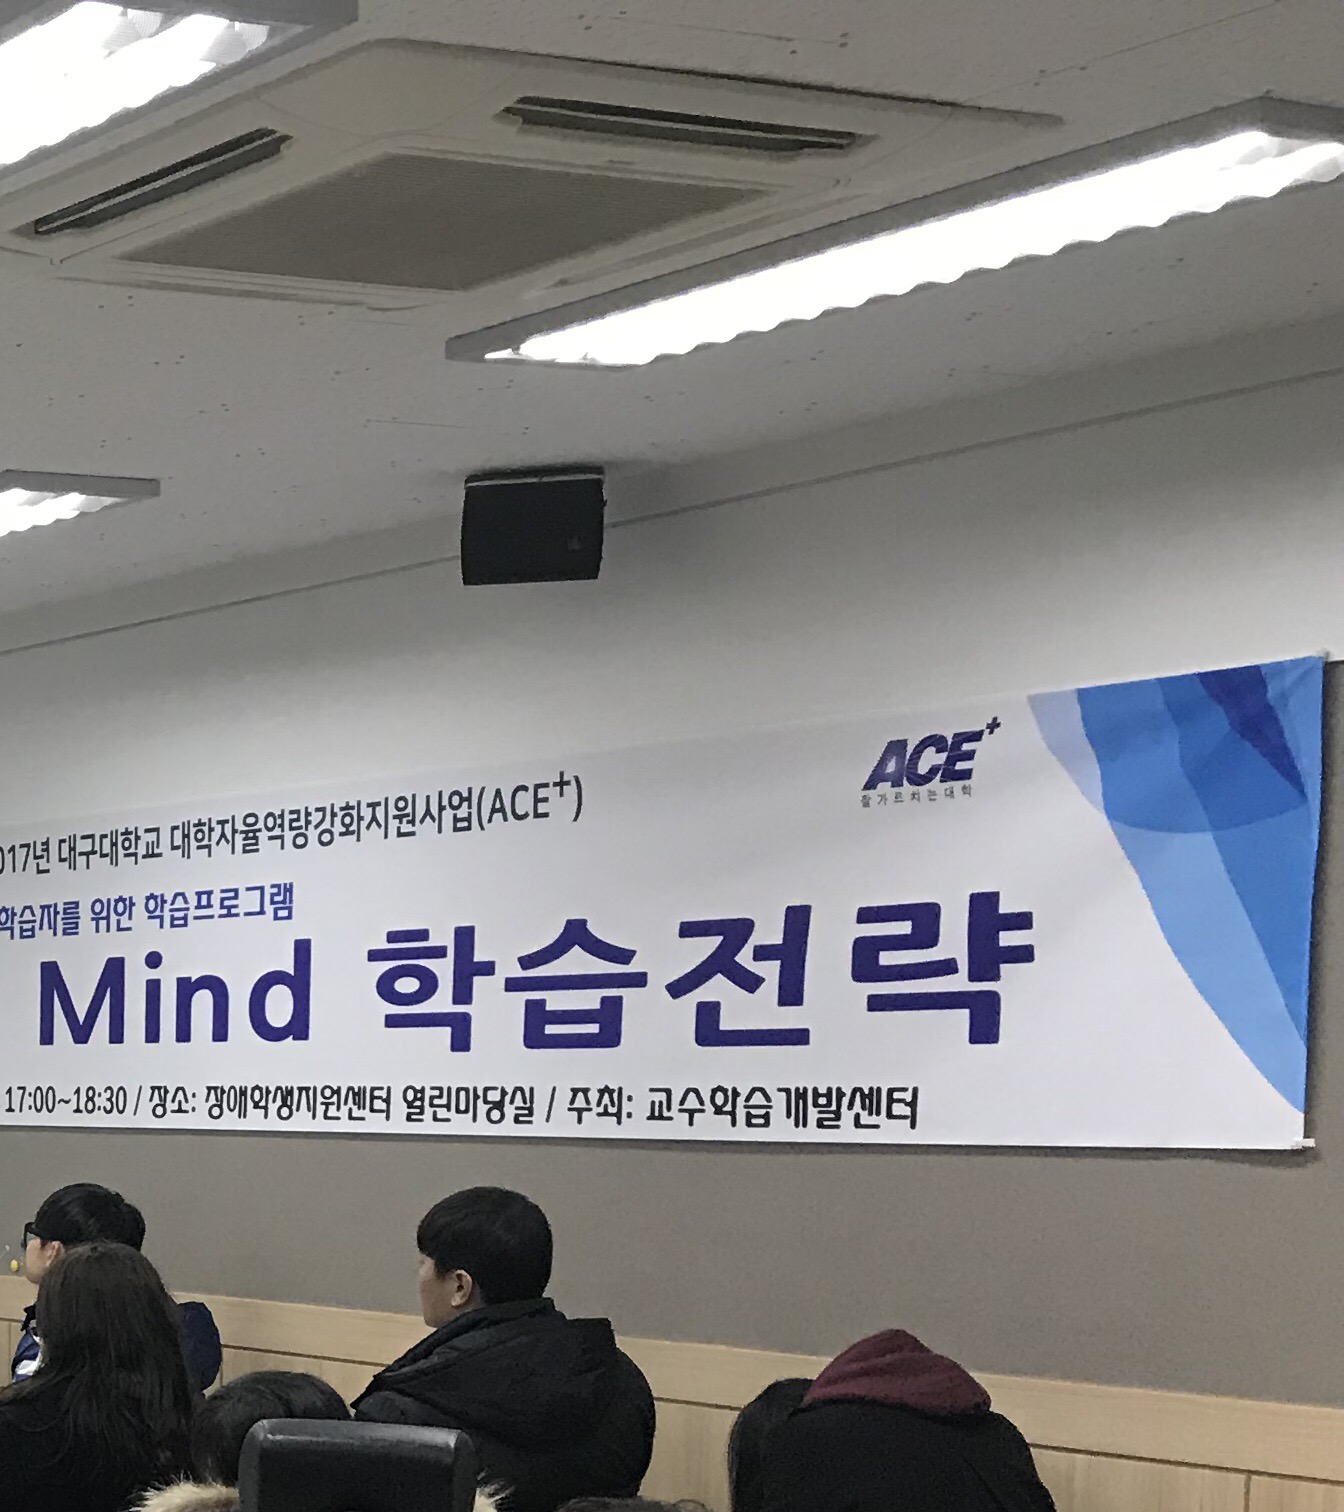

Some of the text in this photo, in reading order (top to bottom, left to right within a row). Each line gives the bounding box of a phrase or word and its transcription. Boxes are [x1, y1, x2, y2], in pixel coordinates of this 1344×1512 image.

[58, 825, 163, 871] 대구대학교
[90, 894, 136, 932] 위한
[143, 880, 295, 928] 학습프로그램
[39, 938, 312, 1044] Mind
[366, 890, 1036, 1053] 학습전략
[5, 1085, 128, 1115] 17:00~18:30
[133, 1086, 144, 1115] /
[149, 1085, 197, 1119] 장소:
[205, 1084, 391, 1121] 장애학생지원센터
[403, 1085, 534, 1124] 열린마당실
[545, 1086, 556, 1123] /
[567, 1084, 633, 1126] 주최:
[646, 1084, 919, 1130] 교수학습개발센터
